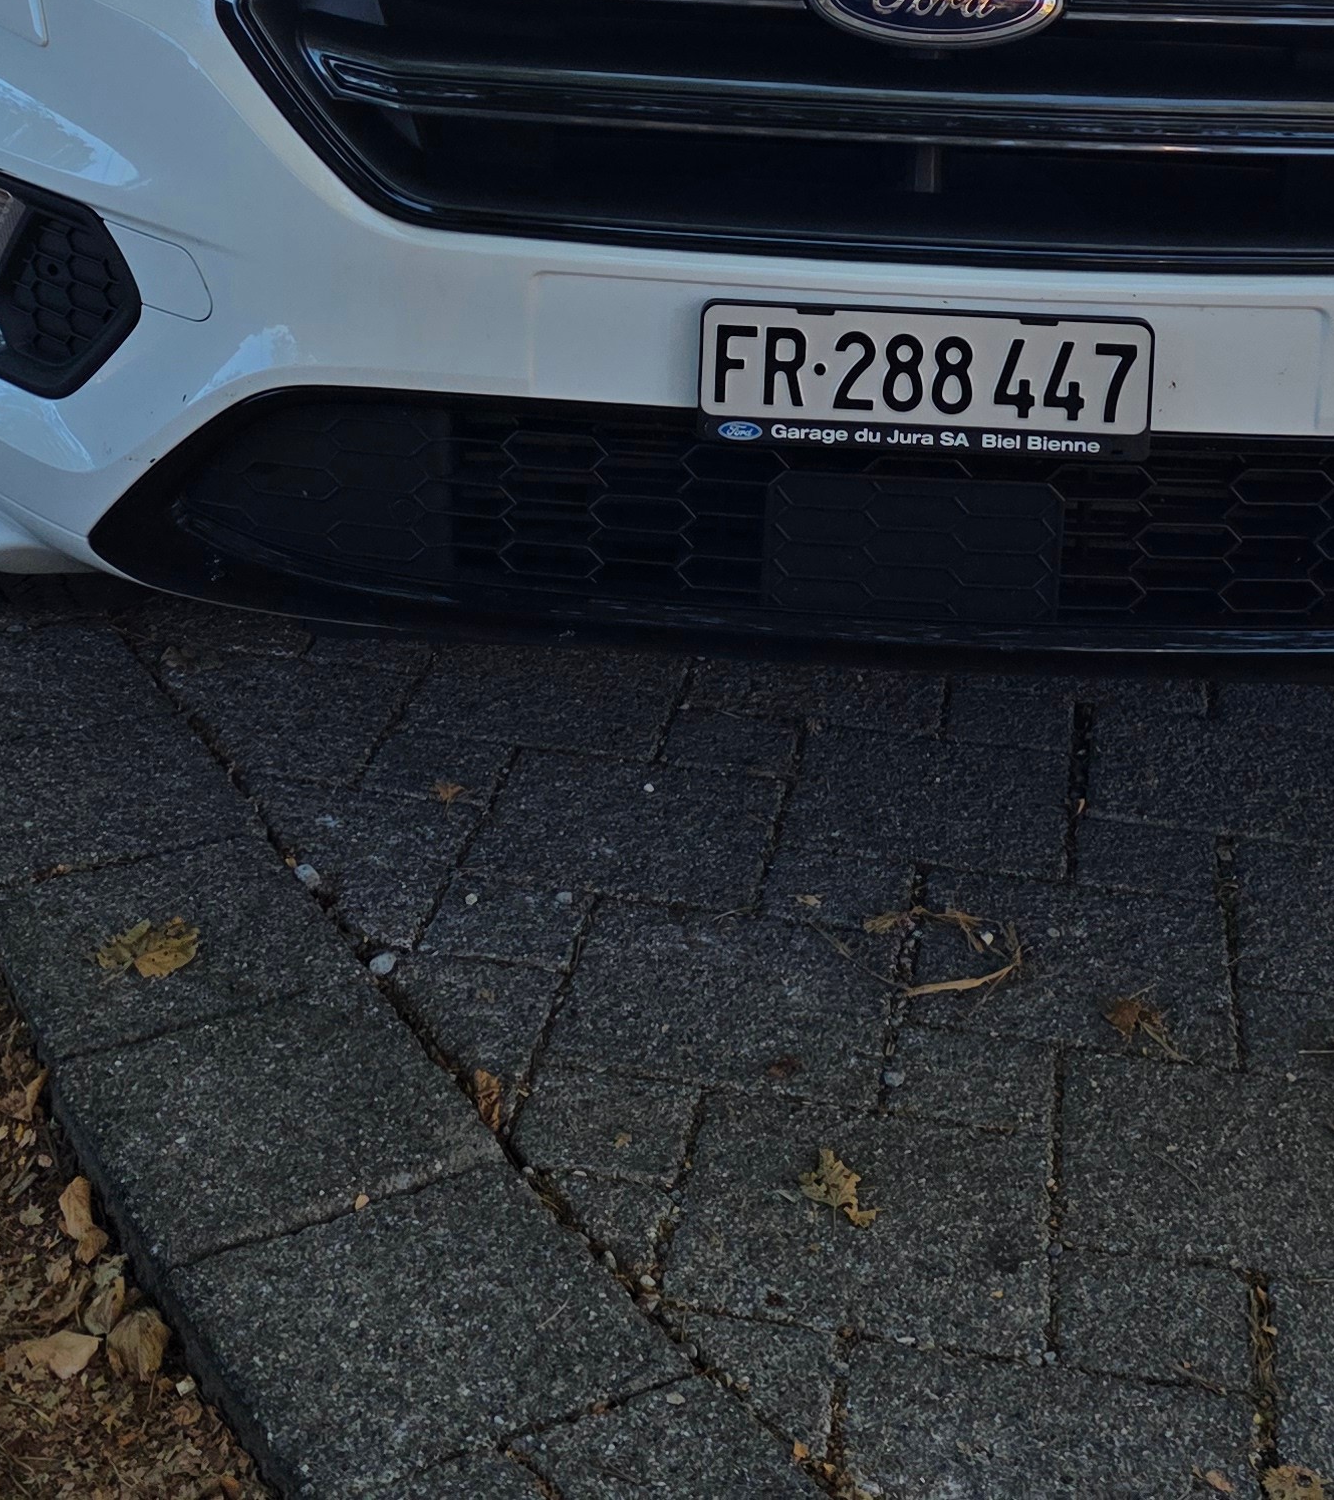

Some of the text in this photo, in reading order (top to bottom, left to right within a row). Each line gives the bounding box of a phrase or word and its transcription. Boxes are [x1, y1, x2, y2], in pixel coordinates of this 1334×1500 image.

[992, 338, 1138, 424] 447
[726, 422, 755, 438] Ford
[770, 423, 1101, 454] Garage du Jura SA Biel Bienne
